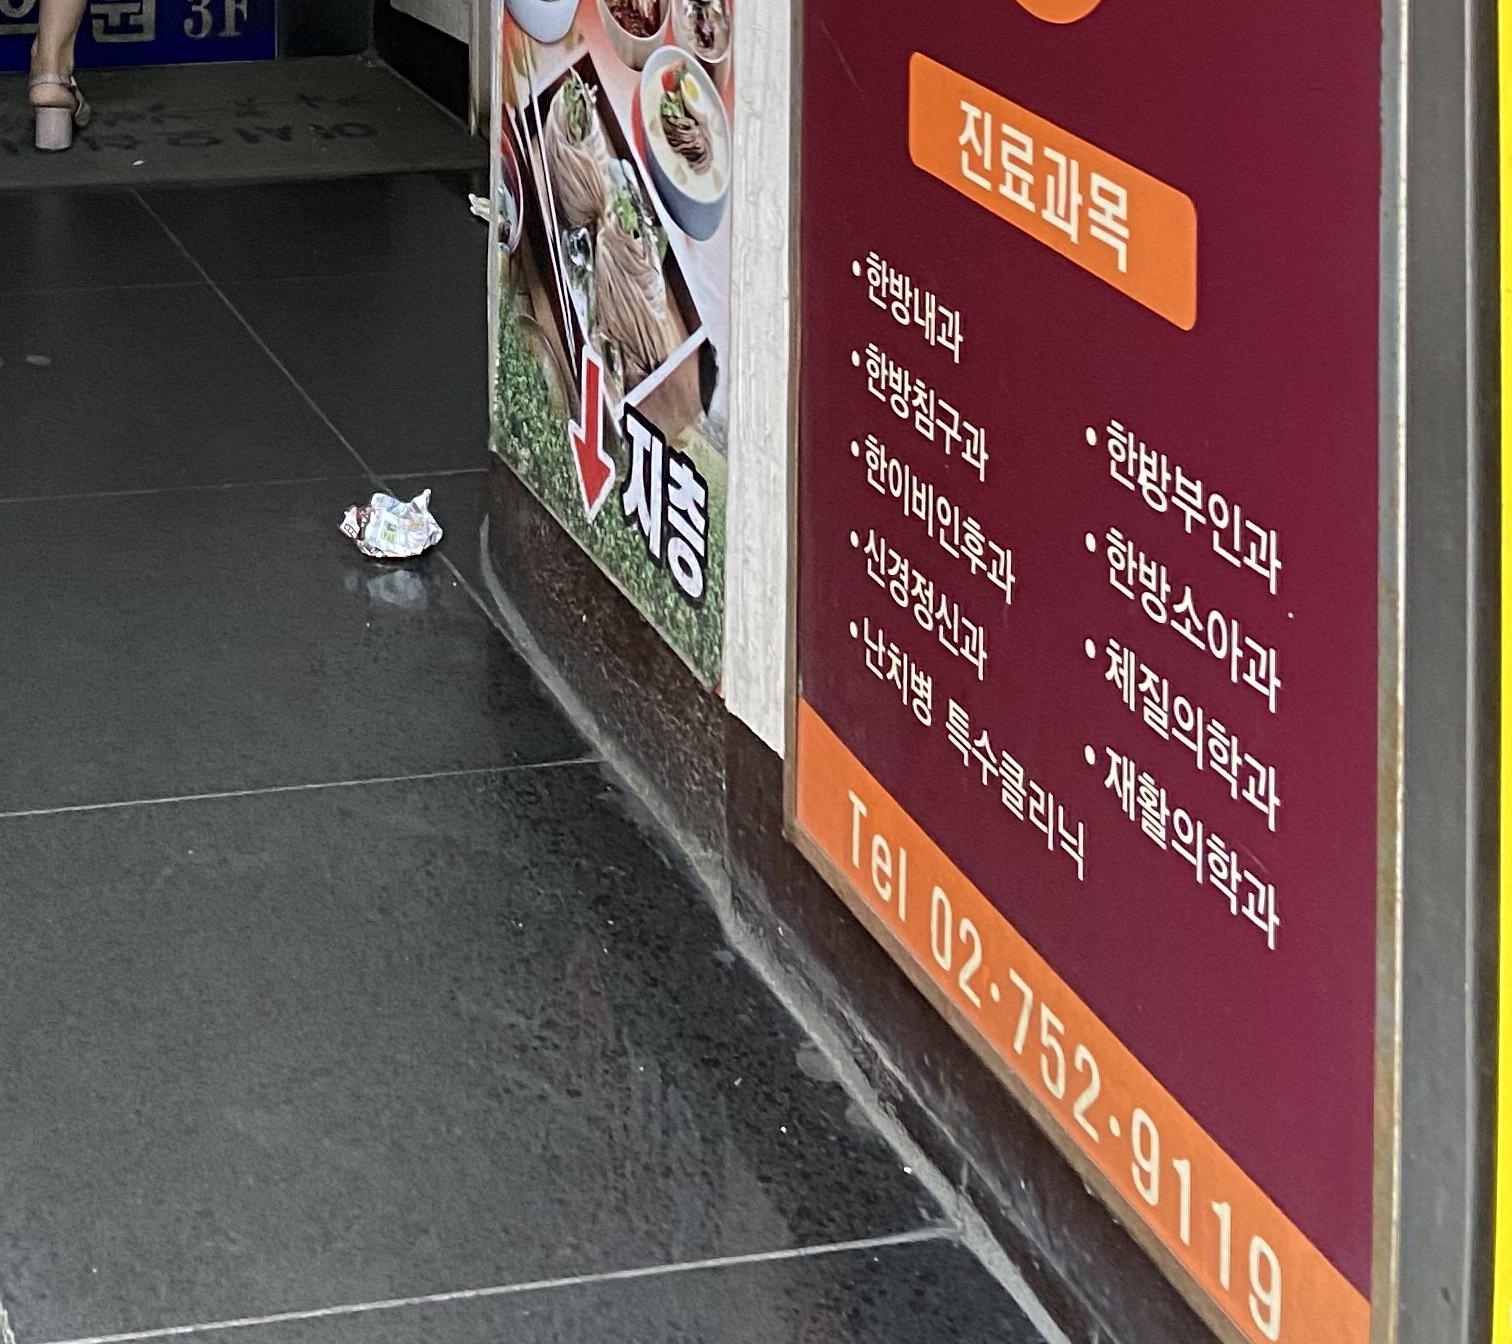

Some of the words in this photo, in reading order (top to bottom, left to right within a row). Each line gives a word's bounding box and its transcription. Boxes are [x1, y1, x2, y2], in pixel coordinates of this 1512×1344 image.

[958, 98, 1130, 274] 진료과목
[865, 250, 964, 365] 한방내과
[864, 342, 990, 483] 한방침구과
[864, 432, 1017, 604] 한이비인후과
[1106, 417, 1283, 595] 한방부인과
[863, 527, 989, 681] 신경정신과
[1105, 525, 1283, 714] 한방소아과
[863, 620, 934, 729] 난치병
[945, 695, 1088, 884] 특수클리닉
[1104, 637, 1283, 832] 체질의학과
[846, 788, 910, 923] Tel
[1103, 744, 1282, 951] 재활의학과
